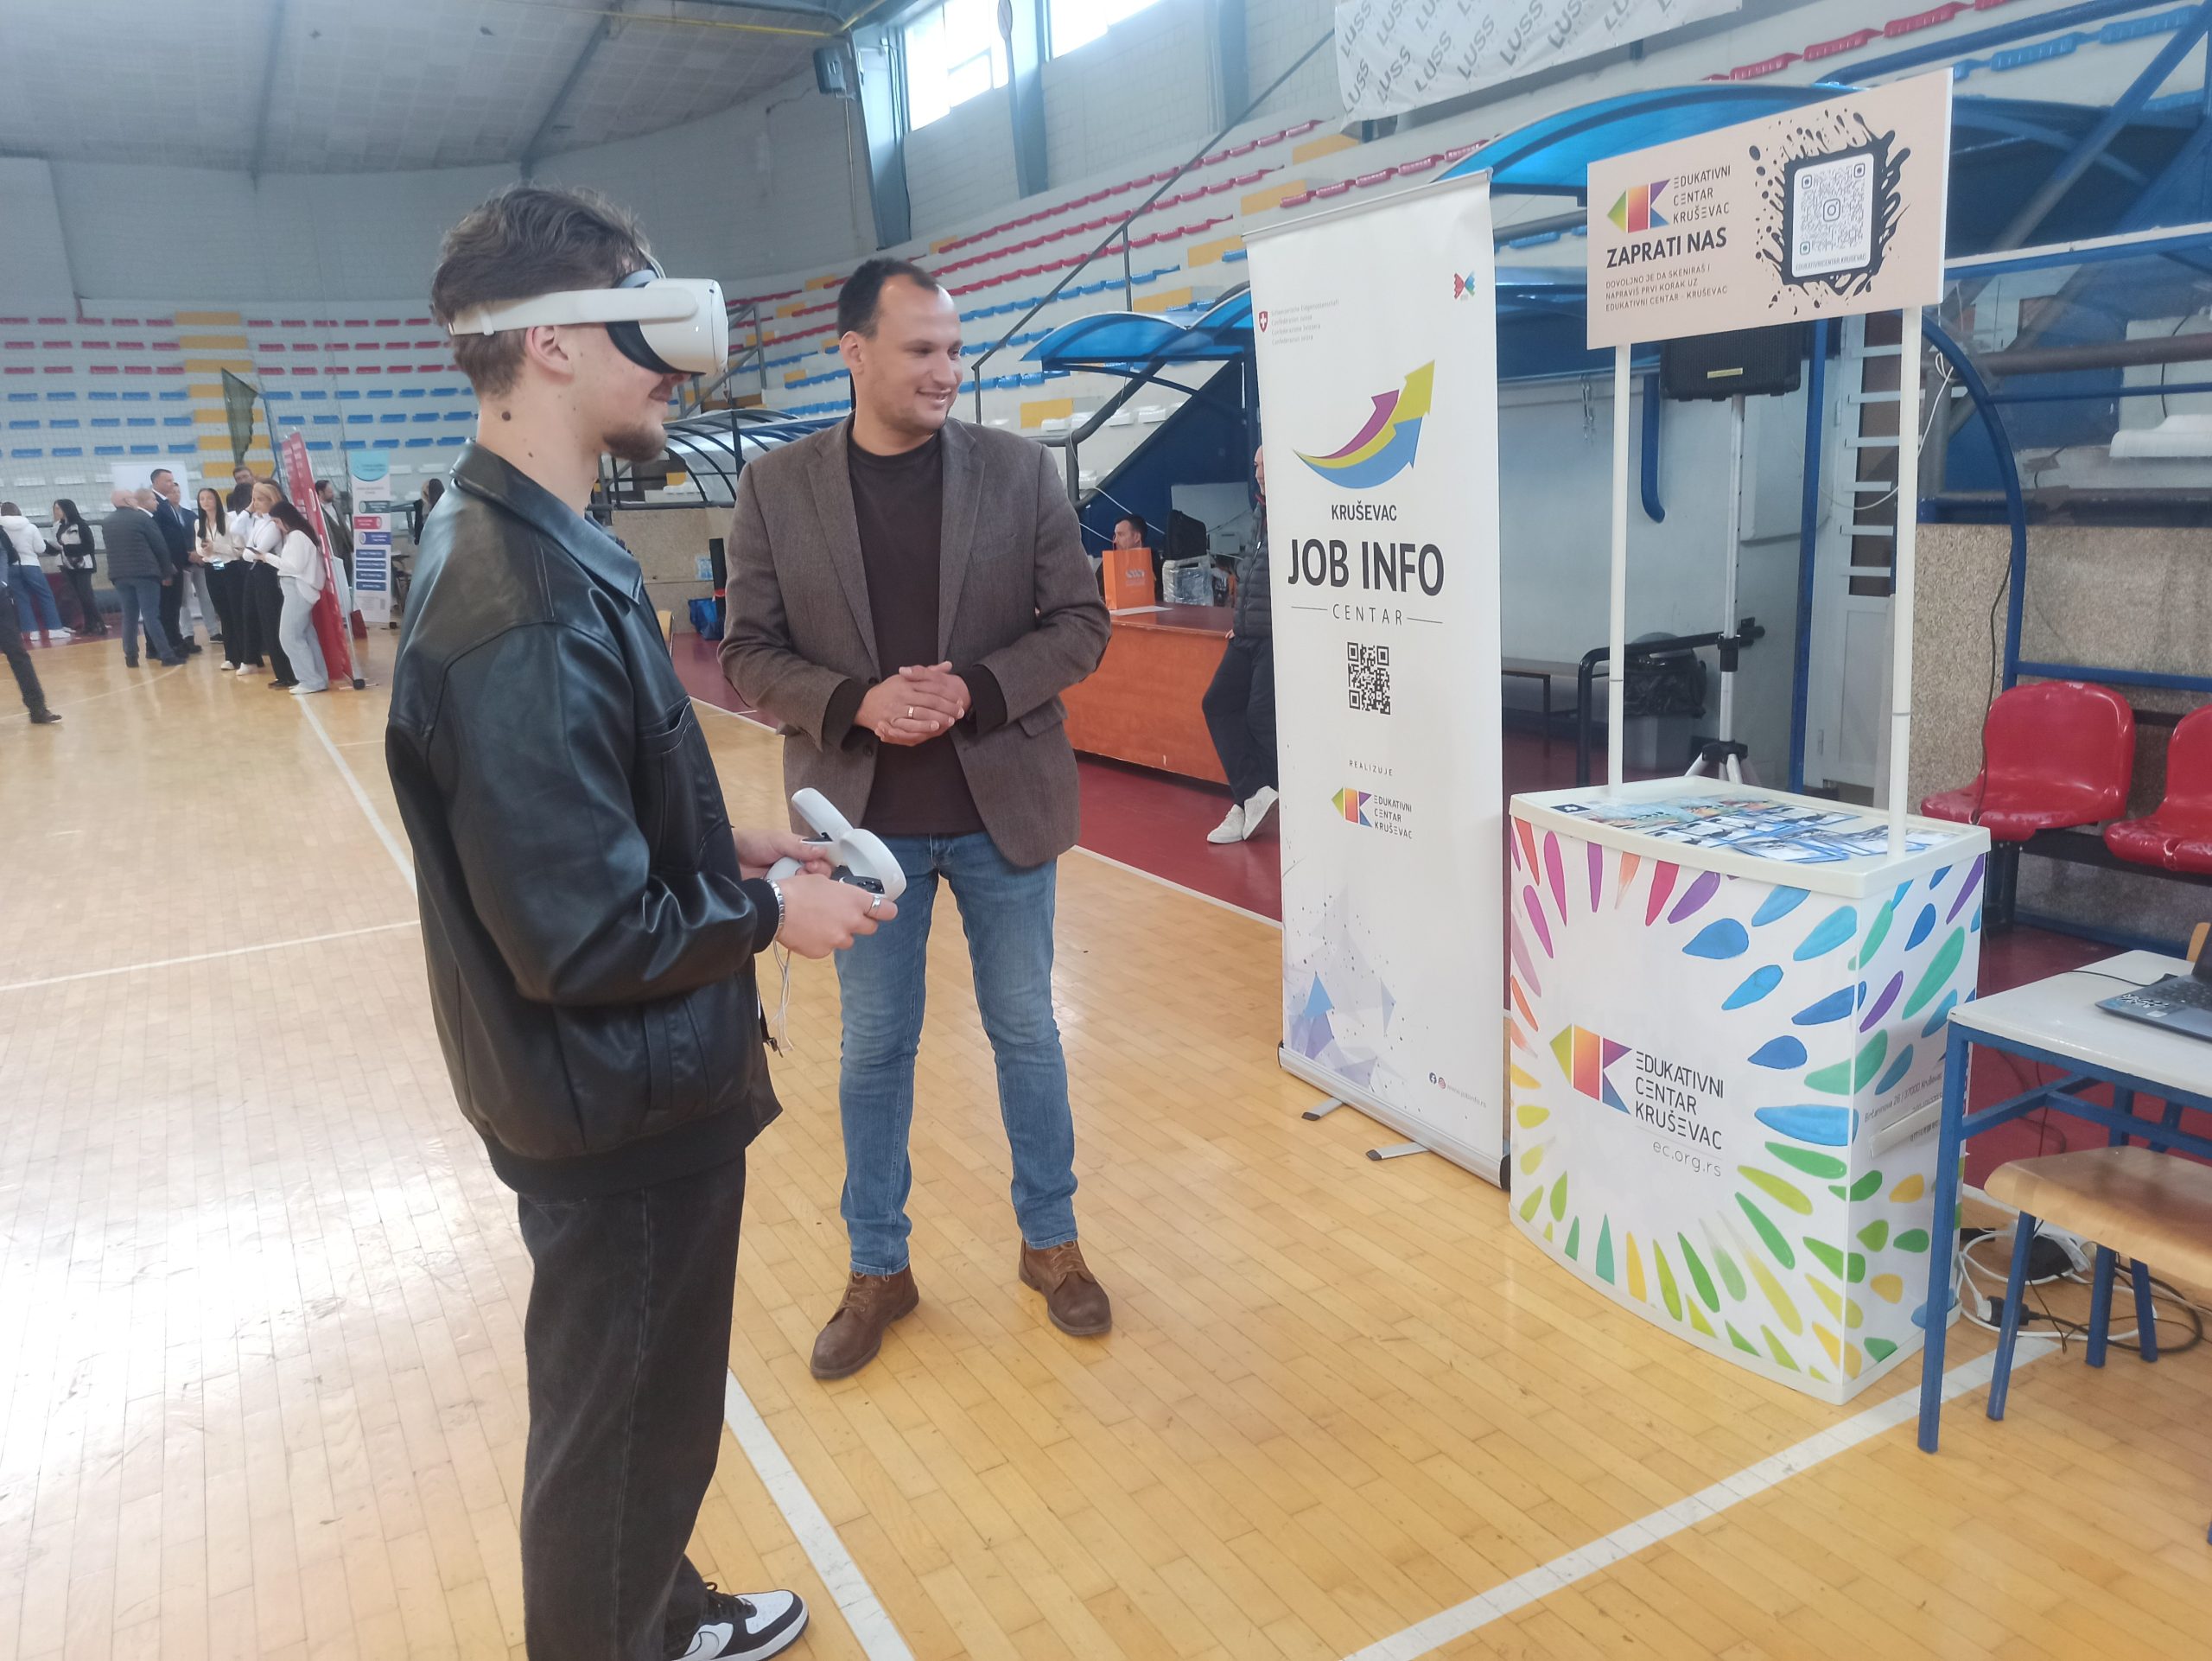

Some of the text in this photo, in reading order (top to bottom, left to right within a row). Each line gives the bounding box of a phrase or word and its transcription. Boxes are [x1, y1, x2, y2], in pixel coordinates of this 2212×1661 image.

[1341, 0, 1372, 58] LUSS
[1376, 0, 1408, 47] LUS
[1500, 0, 1543, 67] LUSS
[1548, 0, 1583, 49] LUS
[1414, 30, 1452, 93] LUSS
[1457, 14, 1495, 80] LUSS
[1342, 58, 1369, 114] LUSS
[1376, 45, 1411, 104] LUSS
[1674, 165, 1731, 189] EDUKATIVNI
[1673, 188, 1713, 207] CENTAR
[1673, 202, 1729, 225] KRUŠEVAC
[1606, 226, 1727, 269] ZAPRATI NAS
[1605, 277, 1644, 290] DOVOLJNO
[1656, 271, 1667, 281] DA
[1605, 285, 1728, 312] EDUKATIVNI CENTAR KRUŠEVAC
[1642, 285, 1657, 295] PRVI
[1659, 281, 1685, 291] KORAK
[1332, 500, 1397, 521] KRUŠEVAC
[1287, 538, 1445, 596] JOB INFO
[1332, 603, 1402, 626] CENTAR
[1349, 760, 1393, 776] REALIZUJE
[1373, 794, 1412, 812] EDUKATIVNI
[1374, 808, 1402, 822] CENTAR
[1374, 821, 1413, 839] KRUŠEVAC
[1636, 1050, 1724, 1098] EDUKATIVNI
[1636, 1076, 1697, 1116] CENTAR
[1636, 1100, 1722, 1150] KRUŠEVAC
[1653, 1142, 1722, 1177] ec.org.rs
